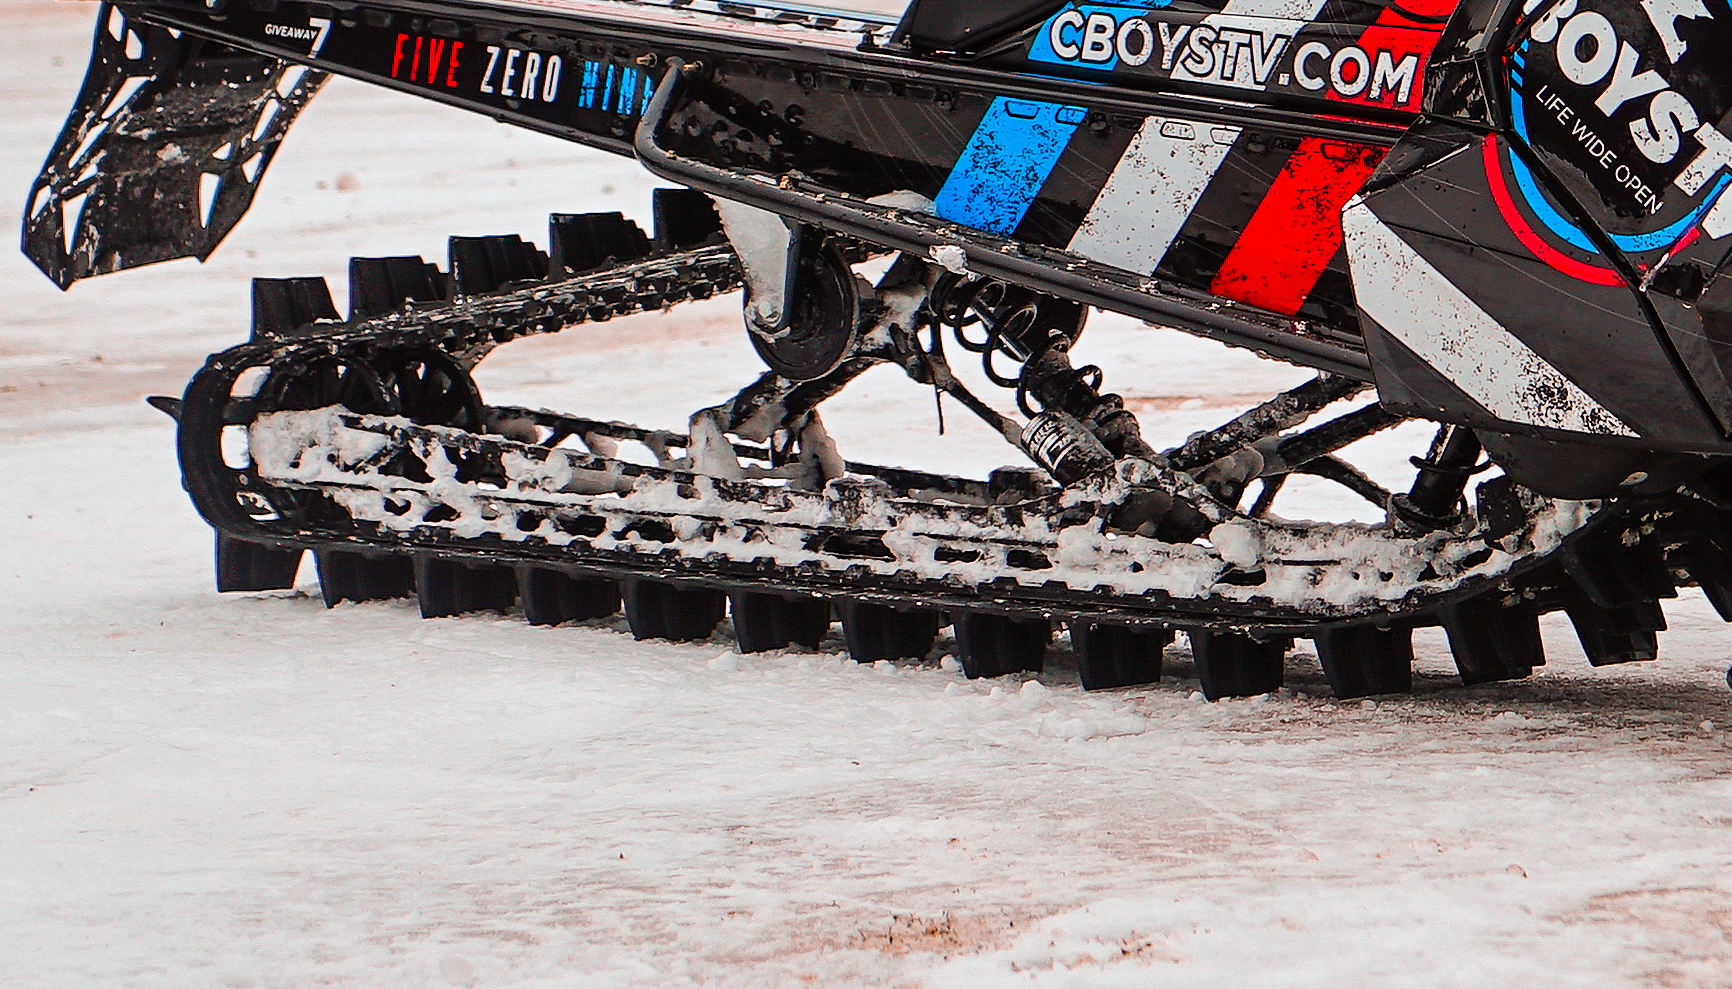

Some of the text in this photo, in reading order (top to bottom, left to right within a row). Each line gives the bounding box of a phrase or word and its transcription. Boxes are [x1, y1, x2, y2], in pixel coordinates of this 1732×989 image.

[264, 16, 334, 60] GIVEAWAY 7
[391, 33, 465, 88] FIVE
[480, 45, 563, 103] ZERO
[1049, 10, 1418, 105] CBOYSTV.COM
[1535, 84, 1664, 214] LIFE WIDE OPEN
